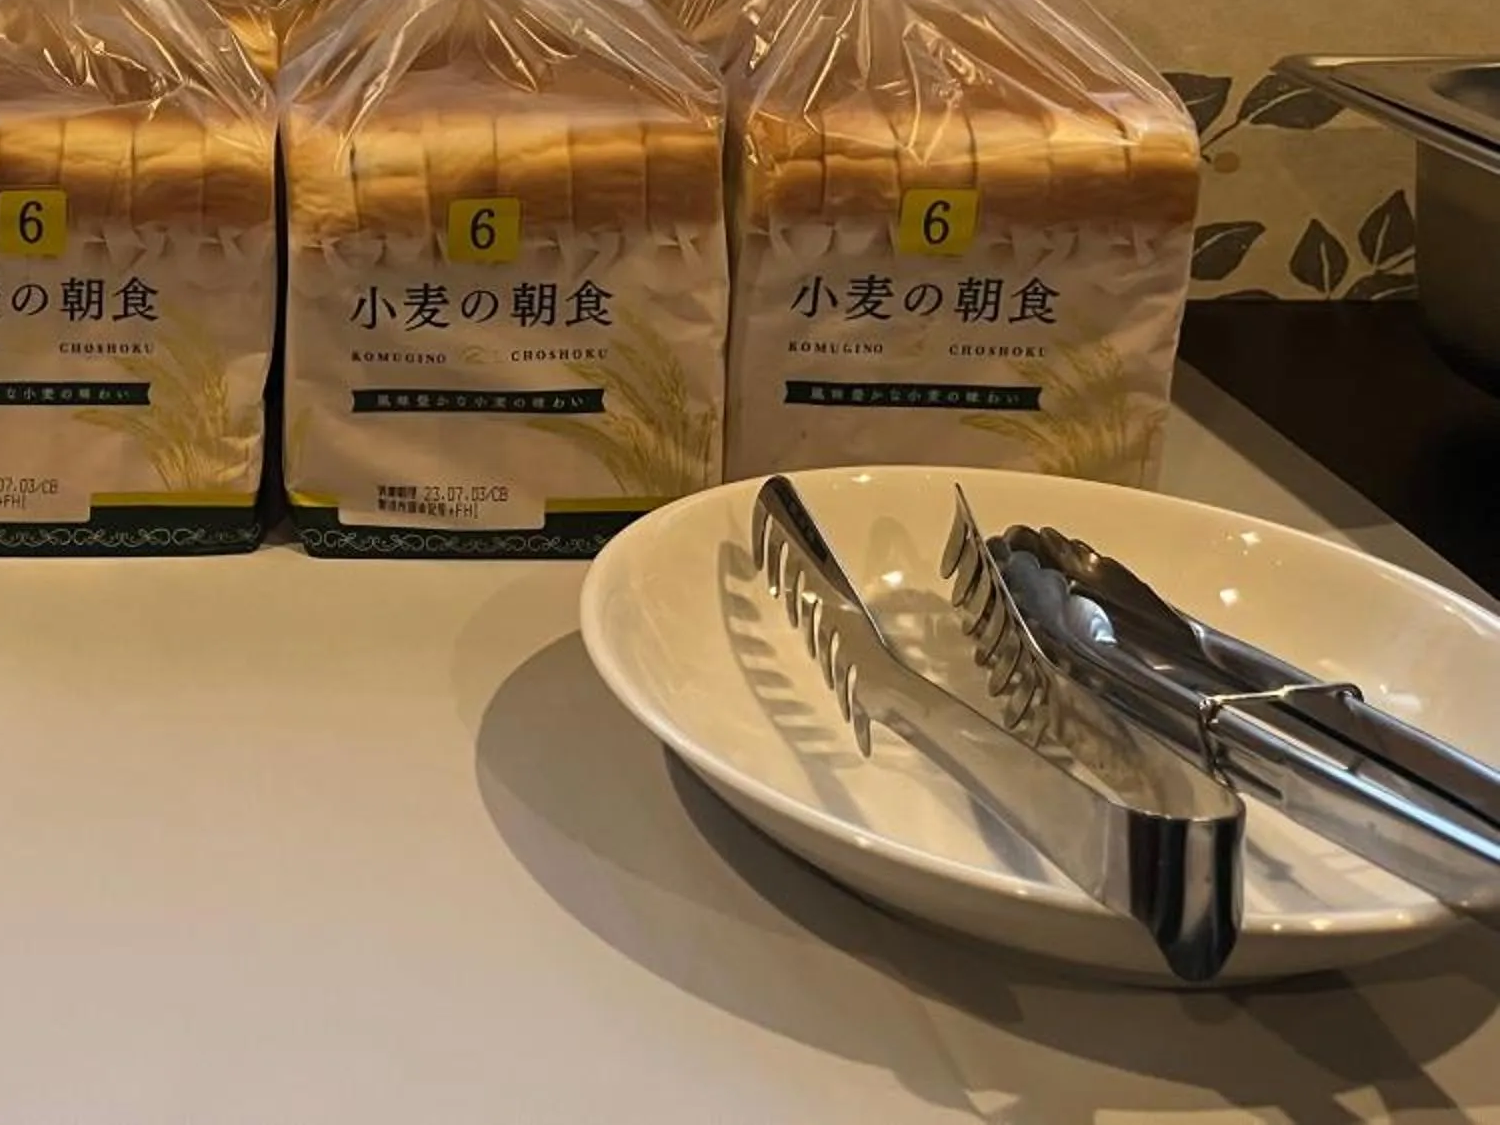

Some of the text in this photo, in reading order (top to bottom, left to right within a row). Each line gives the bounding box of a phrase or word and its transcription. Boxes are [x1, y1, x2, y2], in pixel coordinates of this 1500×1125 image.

[18, 200, 44, 244] 6
[469, 208, 496, 250] 6
[922, 199, 951, 245] 6
[349, 280, 614, 331] 小麦の朝食
[790, 275, 1061, 325] 小麦の朝食
[59, 341, 155, 355] CHOSHOKU
[351, 348, 609, 364] KOMUGINO CHOSHOKU
[787, 341, 884, 355] KOMUGINO
